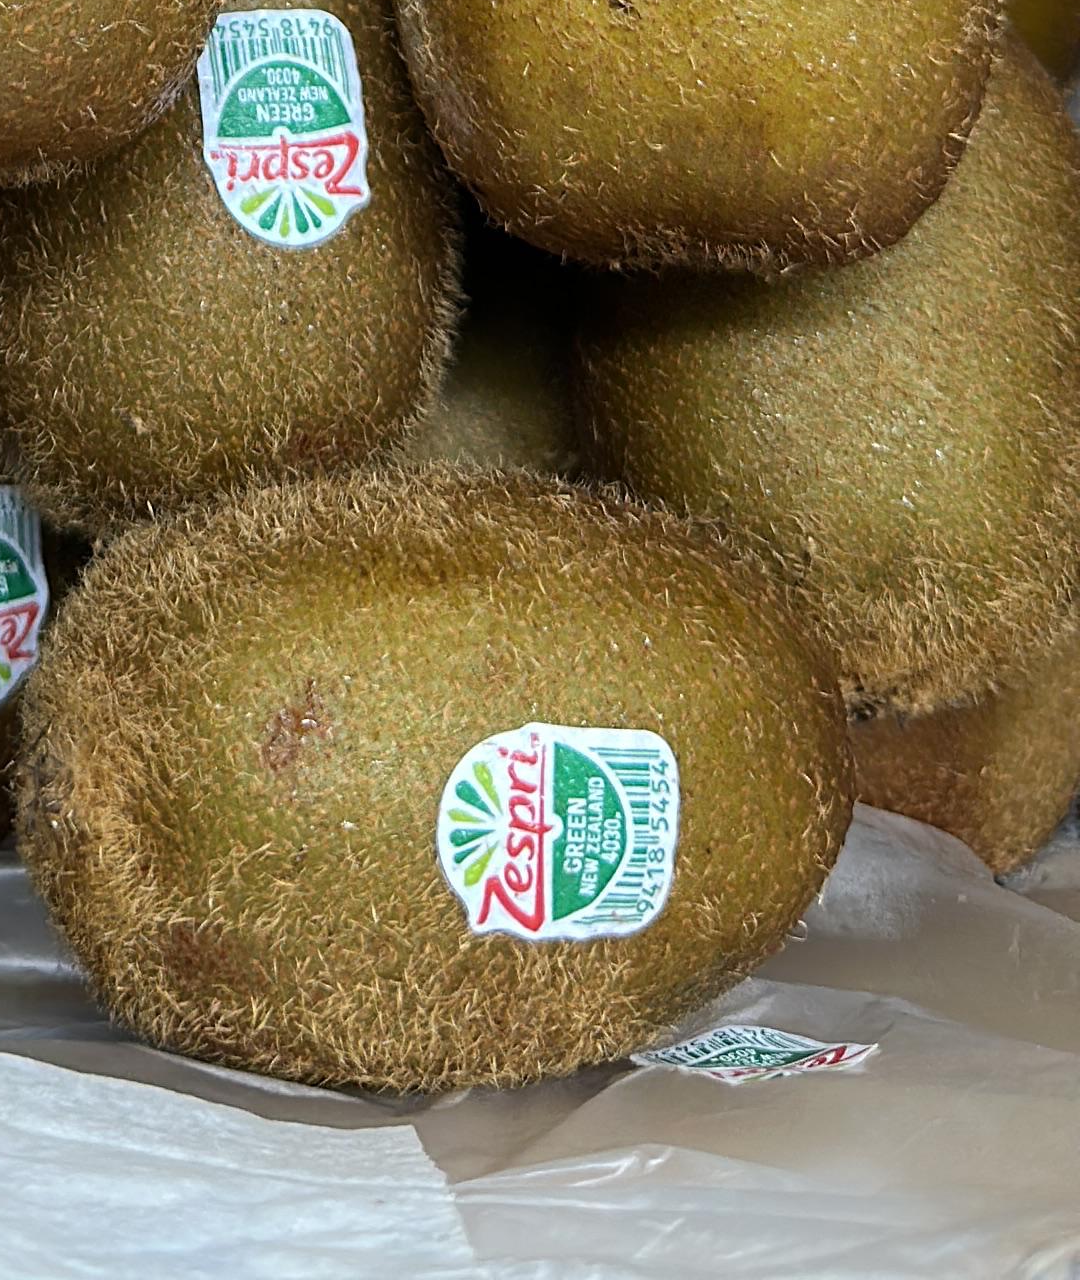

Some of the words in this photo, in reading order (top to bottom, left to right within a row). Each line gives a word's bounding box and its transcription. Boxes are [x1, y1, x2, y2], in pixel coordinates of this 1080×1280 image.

[215, 18, 270, 39] 5454
[280, 17, 334, 38] 9418
[237, 86, 297, 103] ZEALAND
[256, 103, 316, 124] GREEN
[300, 86, 329, 103] NEW
[218, 131, 363, 197] Zespri
[584, 776, 607, 856] ZEALAND
[650, 760, 670, 831] 5454
[477, 744, 553, 931] Zespri
[562, 797, 588, 873] GREEN
[579, 857, 601, 897] NEW
[636, 847, 666, 913] 9418
